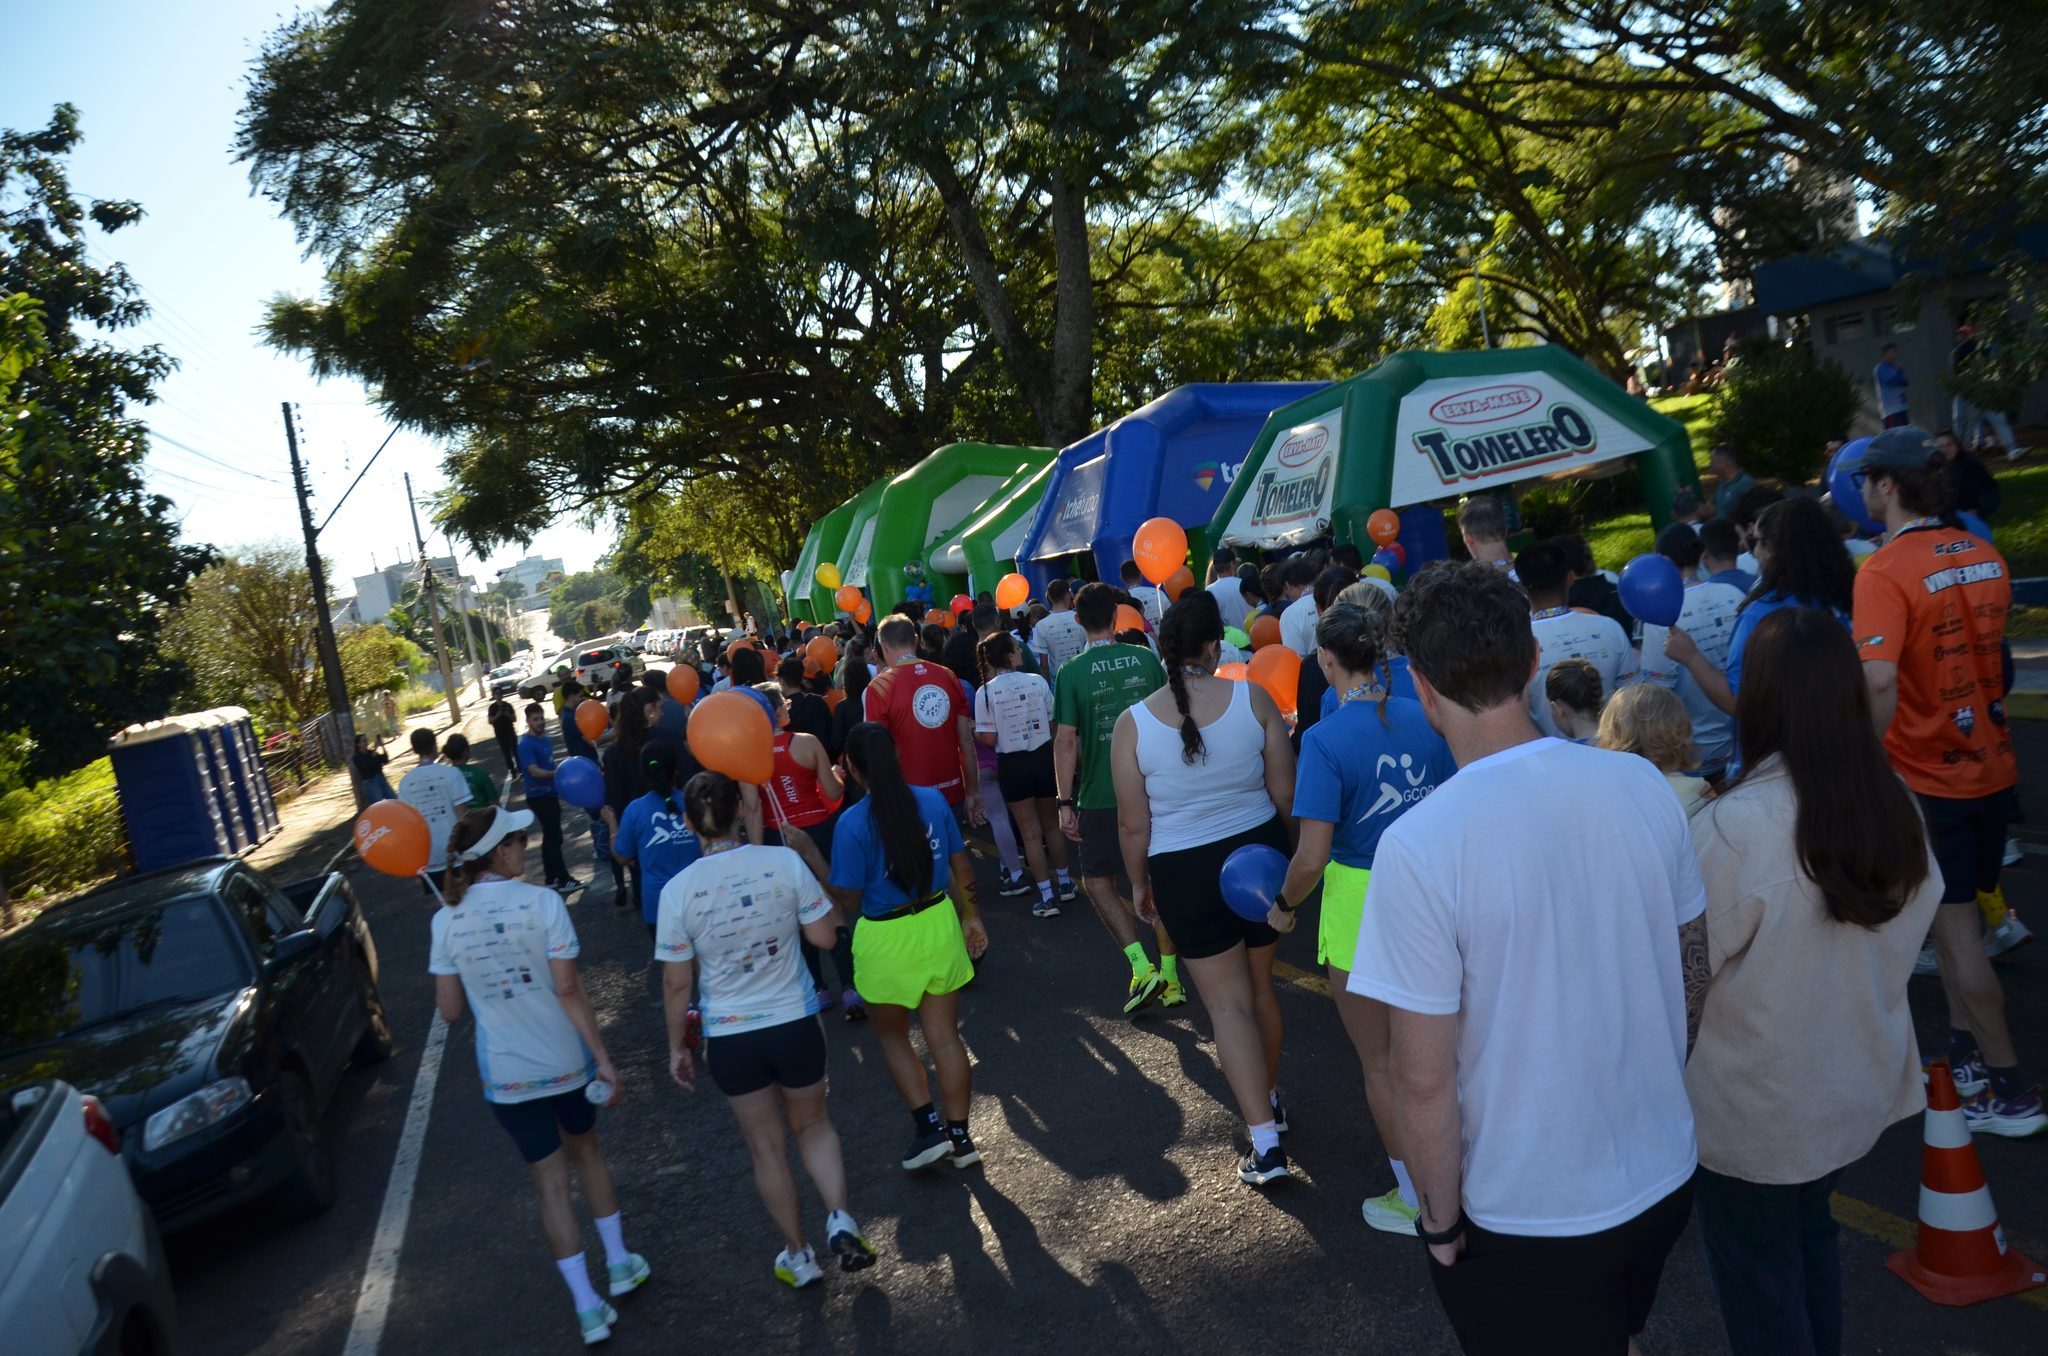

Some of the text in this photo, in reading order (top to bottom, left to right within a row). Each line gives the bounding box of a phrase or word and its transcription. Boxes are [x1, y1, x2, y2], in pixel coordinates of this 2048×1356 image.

[1441, 389, 1532, 418] ERVA-MATE
[1414, 403, 1595, 481] TOMELERO
[1253, 452, 1332, 522] TOMELERO
[1091, 655, 1141, 674] ATLETA
